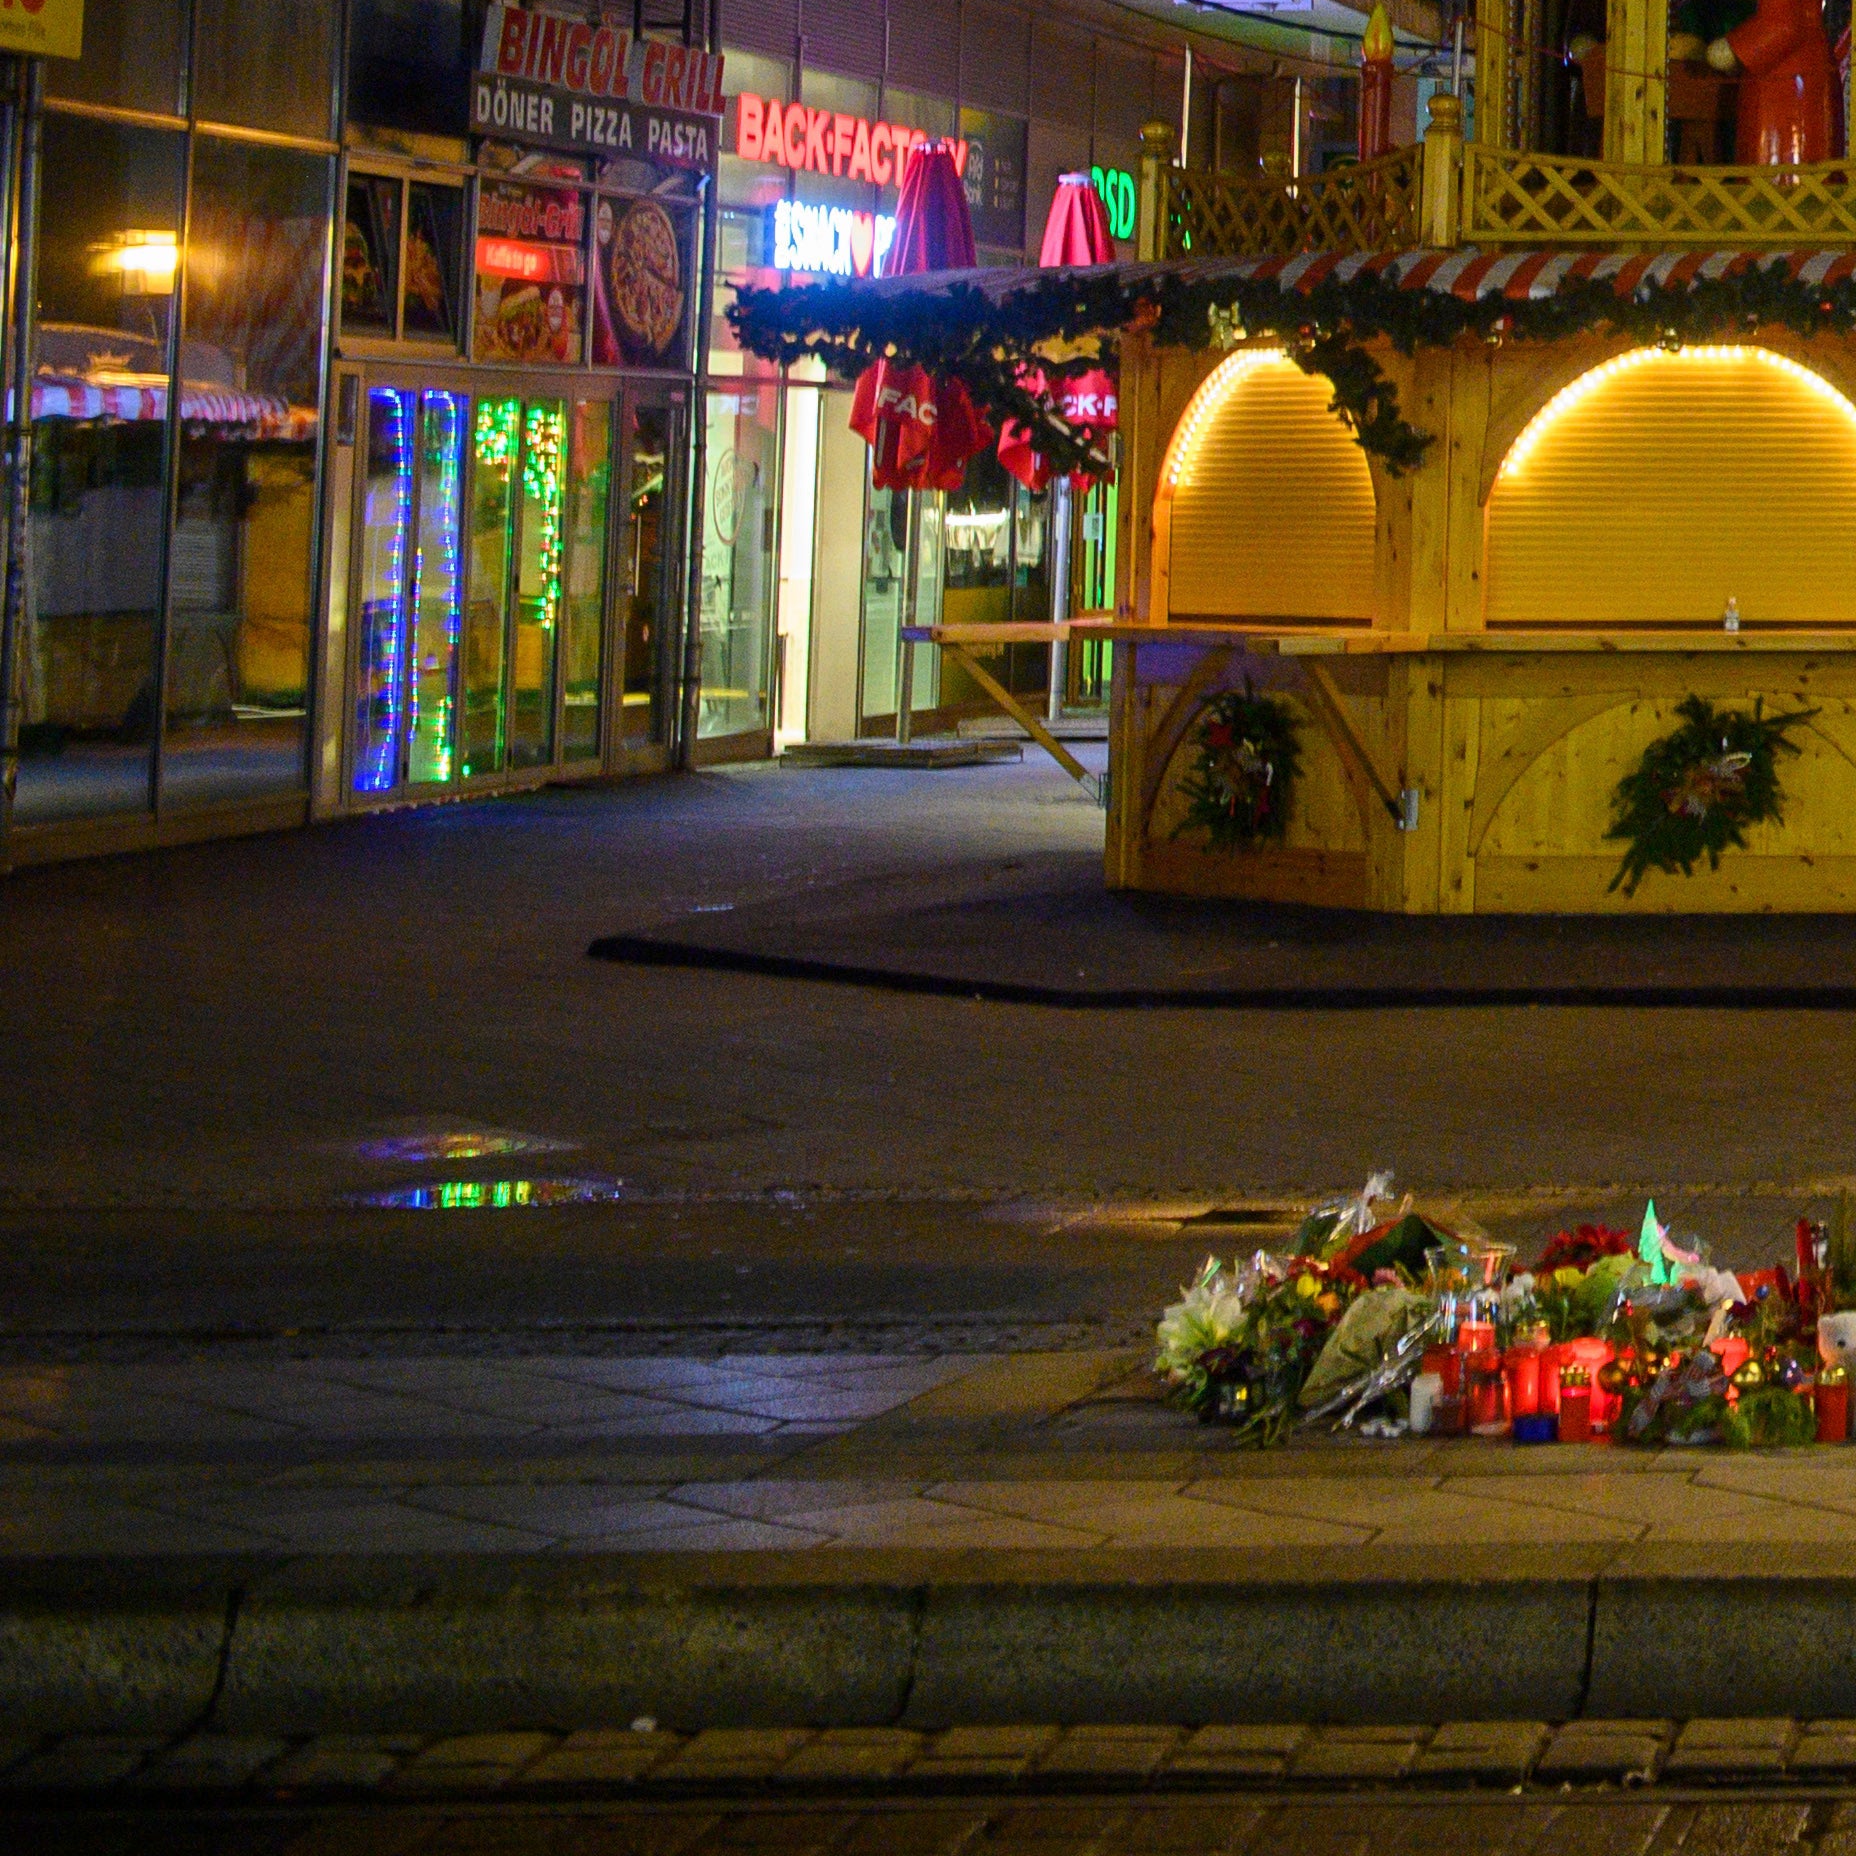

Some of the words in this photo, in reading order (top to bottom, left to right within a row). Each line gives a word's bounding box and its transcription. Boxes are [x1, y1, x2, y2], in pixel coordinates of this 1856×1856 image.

[496, 6, 630, 99] BINGÖL
[641, 40, 727, 114] GRILL
[476, 79, 554, 135] DÖNER
[571, 101, 633, 149] PIZZA
[648, 117, 709, 162] PASTA
